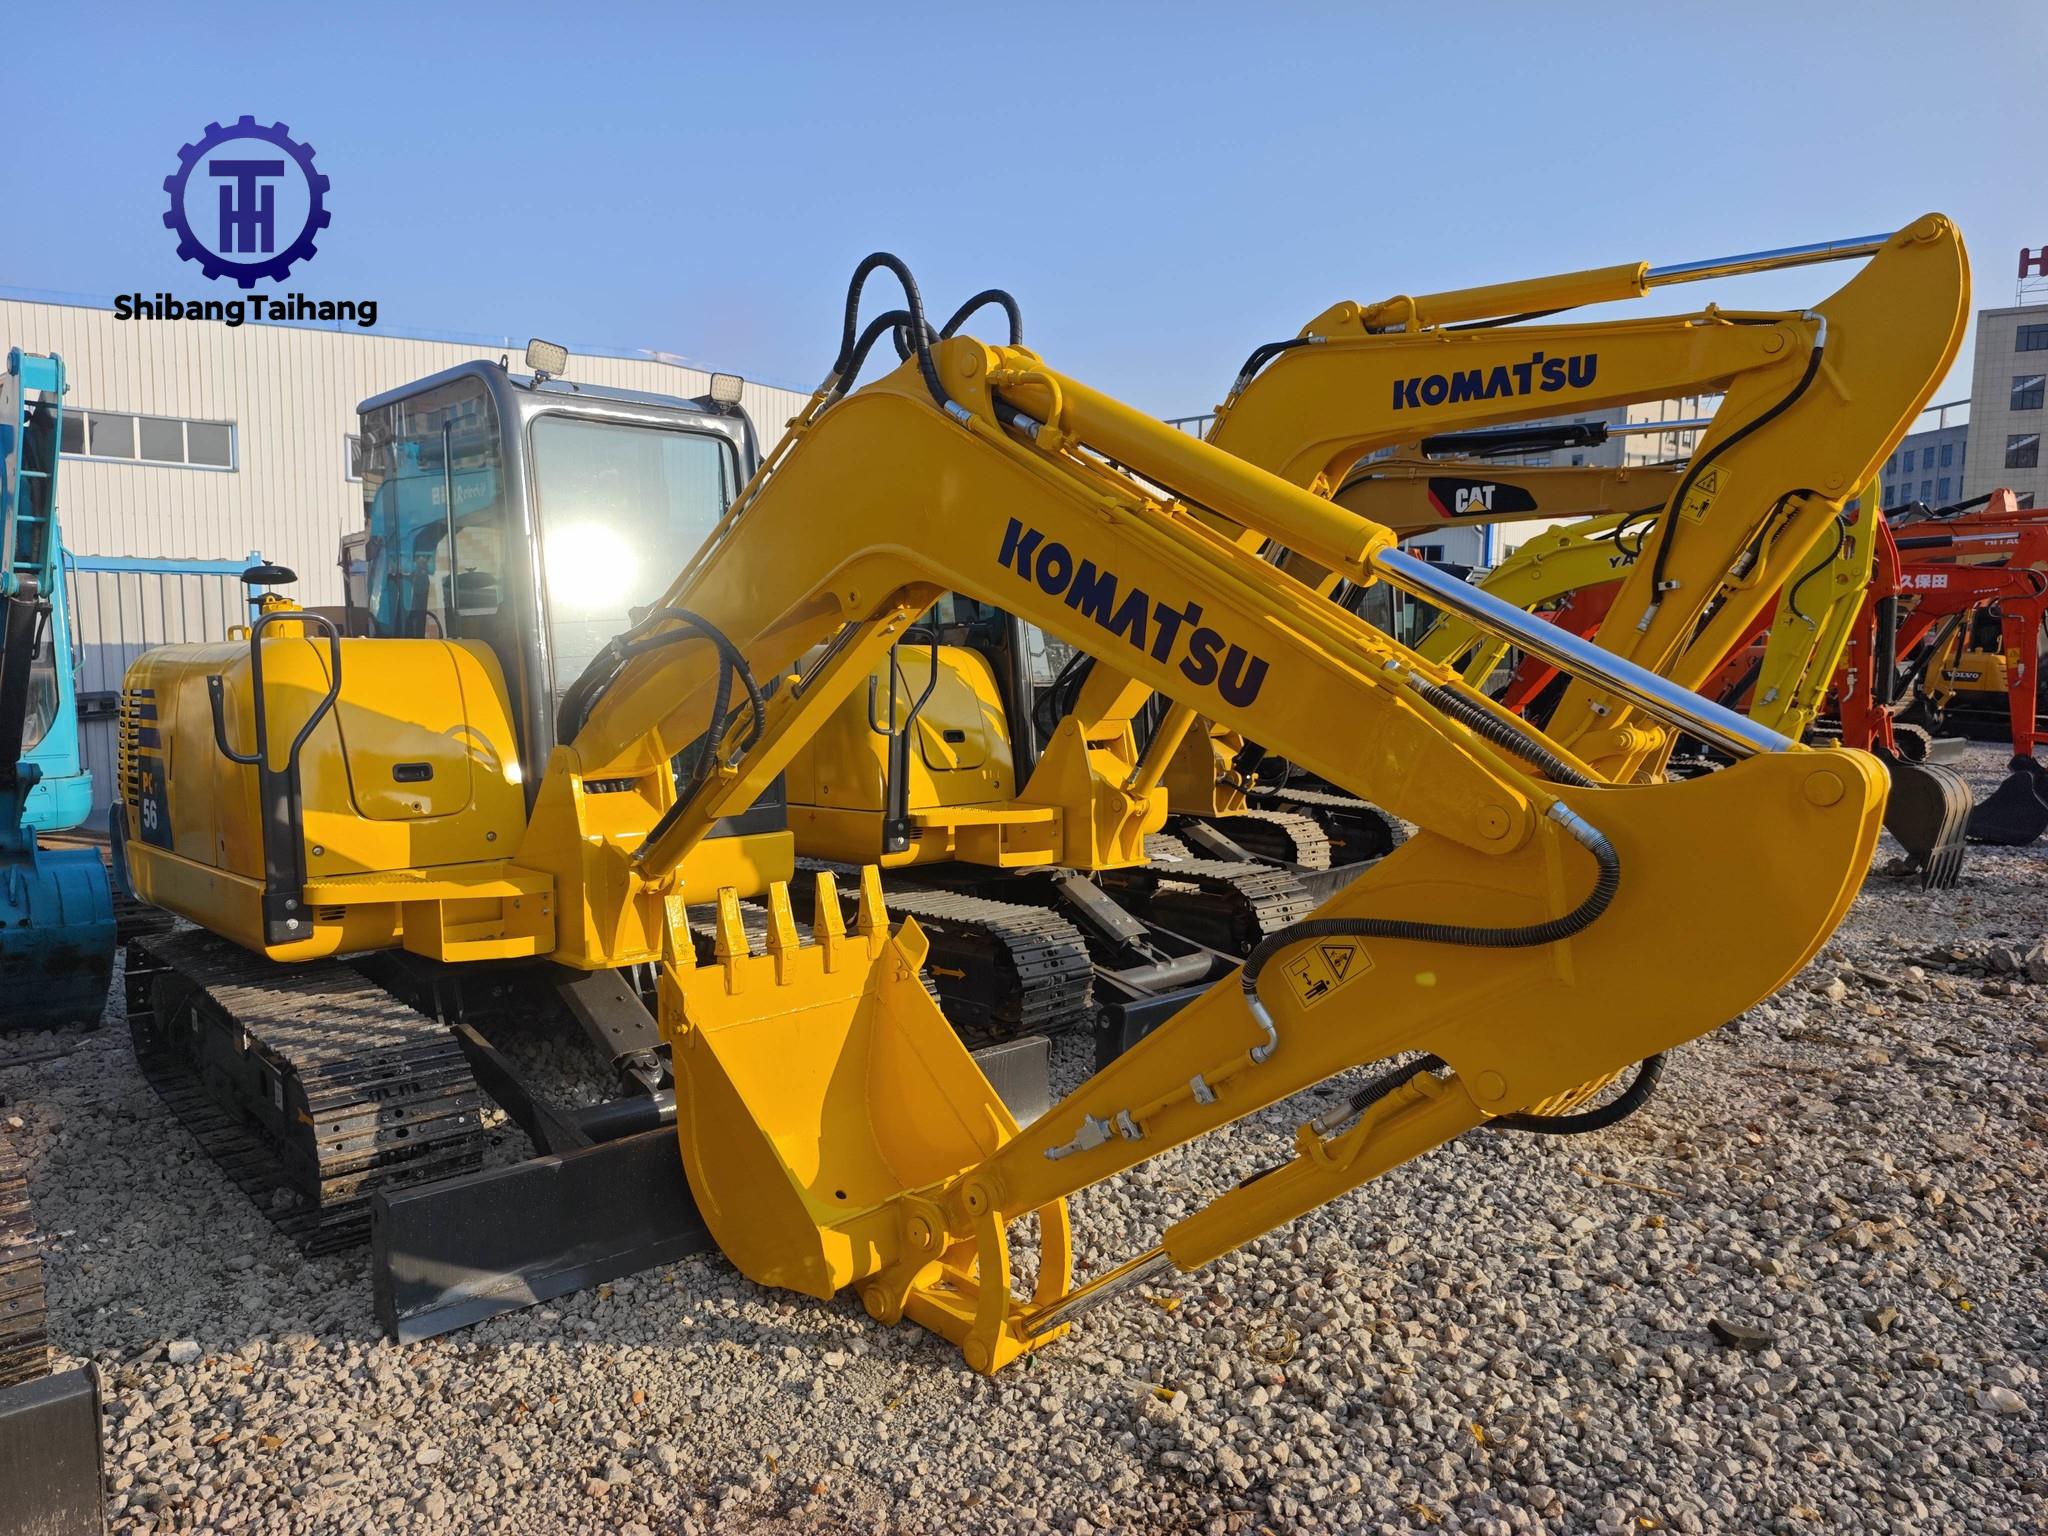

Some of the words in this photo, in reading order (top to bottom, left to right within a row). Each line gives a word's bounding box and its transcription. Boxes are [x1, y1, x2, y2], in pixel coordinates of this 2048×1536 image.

[1393, 352, 1598, 410] KOMATSU
[1455, 485, 1496, 513] CAT
[1901, 574, 1948, 588] 久保田
[998, 517, 1270, 708] KOMATSU
[1947, 671, 1979, 679] VOLVO
[143, 798, 157, 830] 56
